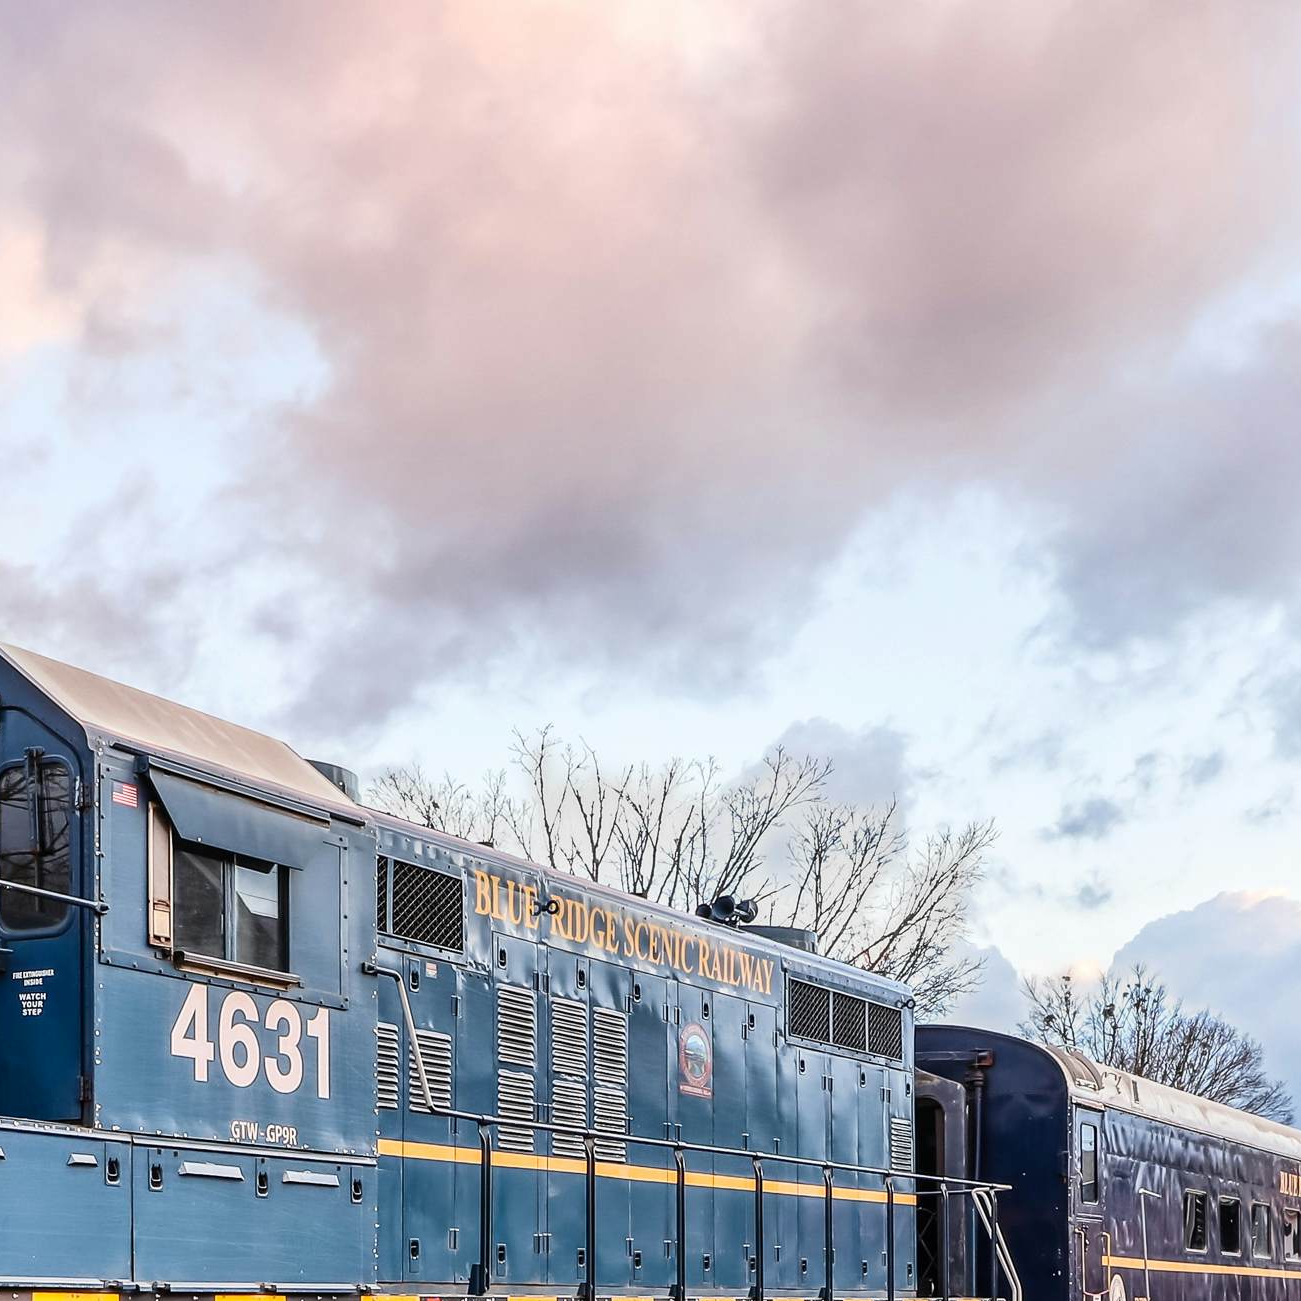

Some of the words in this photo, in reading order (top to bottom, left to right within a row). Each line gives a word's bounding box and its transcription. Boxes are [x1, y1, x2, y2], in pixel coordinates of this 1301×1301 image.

[474, 869, 539, 929] BLUE
[550, 895, 620, 955] RIDGE
[623, 915, 695, 974] SCENIC
[697, 937, 775, 996] RAILWAY
[19, 992, 47, 1001] WATCH
[21, 1000, 44, 1008] YOUR
[22, 1008, 43, 1016] STEP
[171, 982, 331, 1100] 4631
[230, 1120, 259, 1141] GTW
[265, 1124, 297, 1145] GP9R
